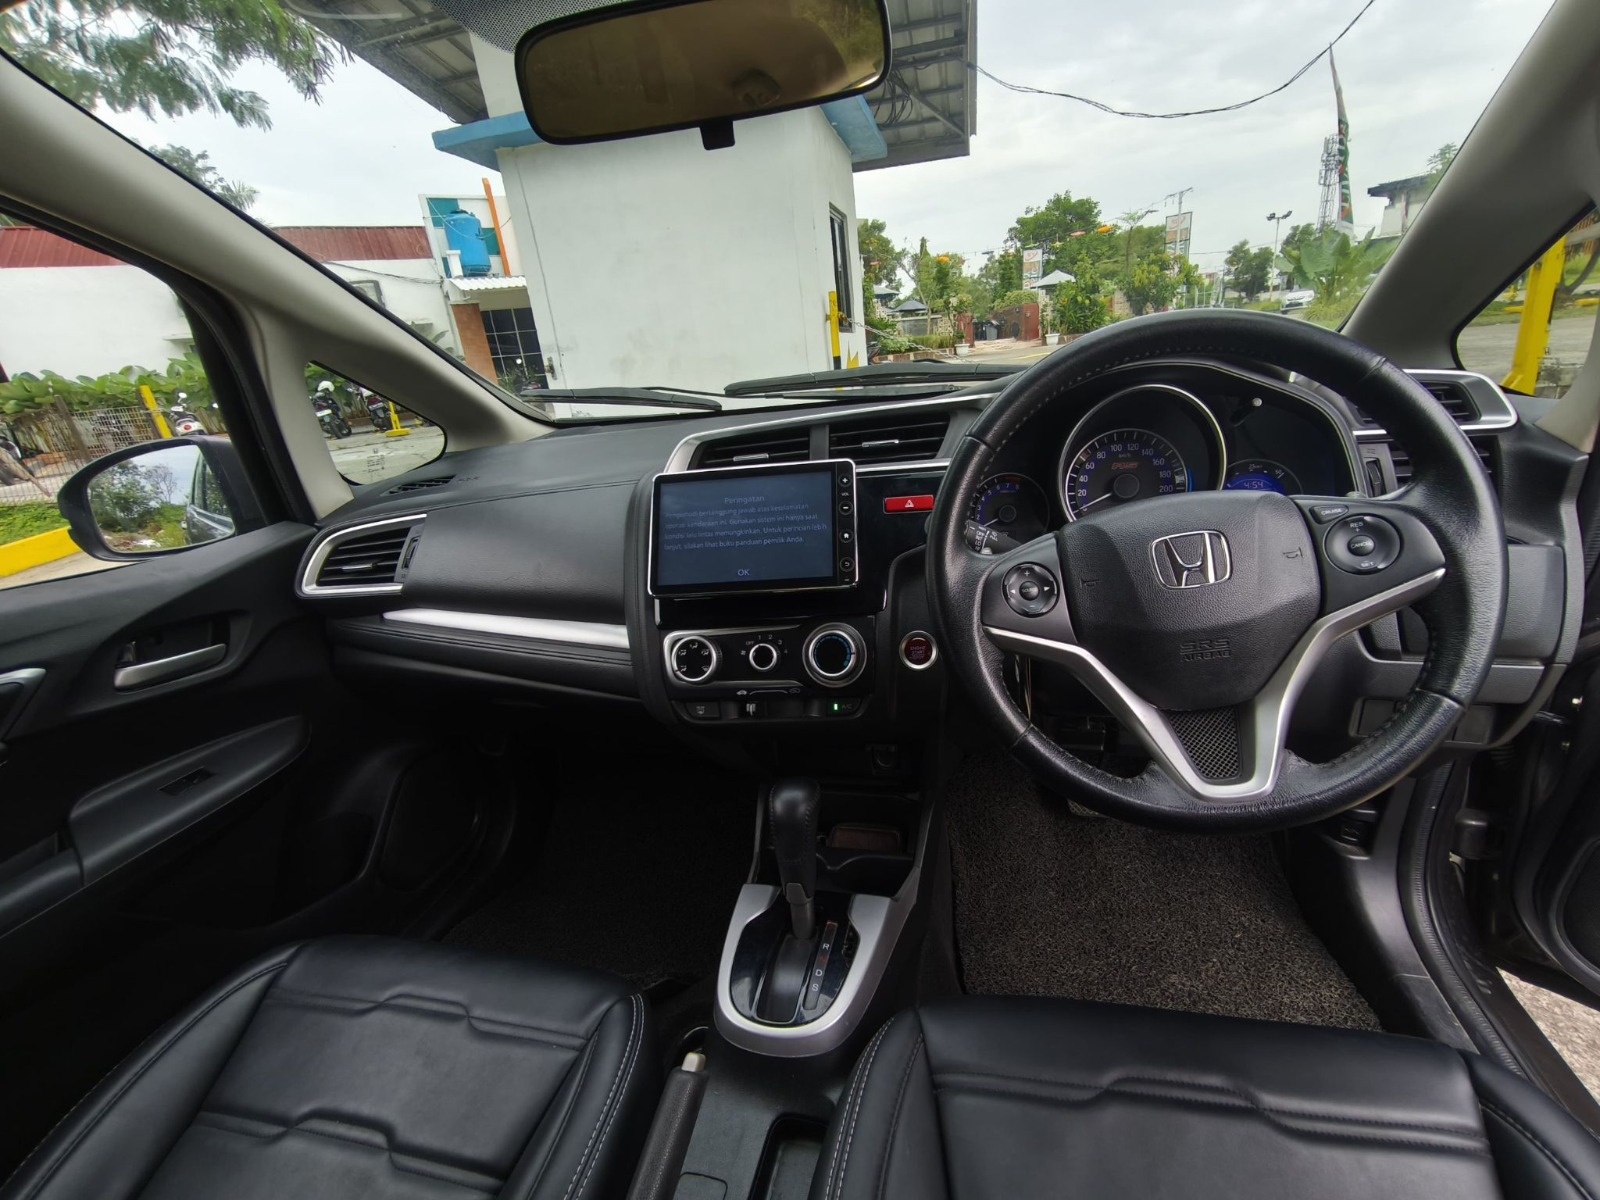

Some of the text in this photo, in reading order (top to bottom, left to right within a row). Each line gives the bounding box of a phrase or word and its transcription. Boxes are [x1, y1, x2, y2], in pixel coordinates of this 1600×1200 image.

[1111, 444, 1122, 452] 100
[1128, 443, 1140, 451] 120
[1097, 451, 1106, 459] 80
[1142, 448, 1154, 456] 140
[1086, 462, 1095, 470] 60
[1153, 458, 1165, 466] 160
[1160, 470, 1172, 478] 180
[1079, 475, 1088, 483] 40
[1077, 488, 1087, 497] 20
[1160, 485, 1174, 493] 200
[725, 496, 765, 505] Peringatan
[763, 525, 782, 534] Untuk
[705, 539, 719, 547] lihat
[719, 538, 735, 547] buku
[736, 537, 763, 547] panduan
[763, 536, 784, 545] pemilik
[737, 568, 751, 576] OK
[812, 983, 819, 992] S
